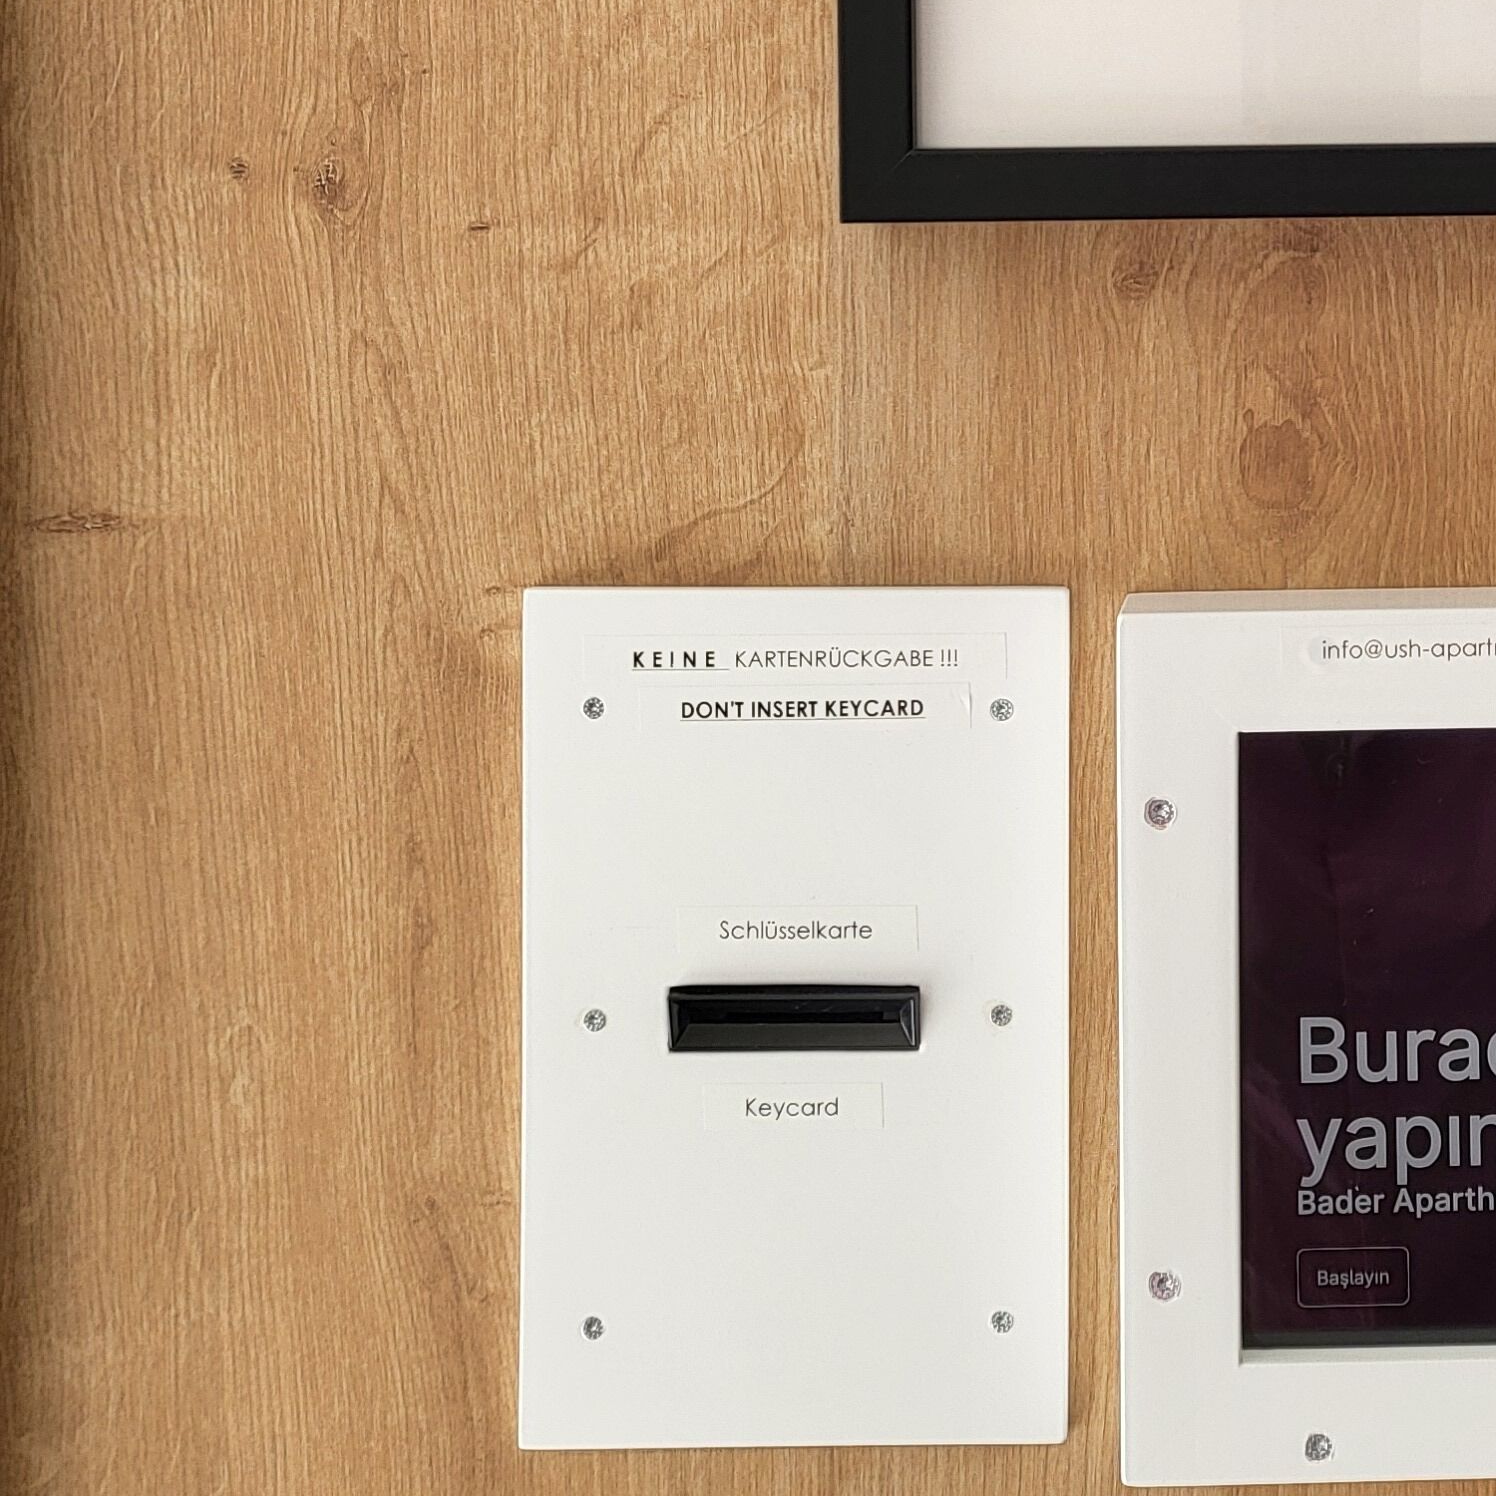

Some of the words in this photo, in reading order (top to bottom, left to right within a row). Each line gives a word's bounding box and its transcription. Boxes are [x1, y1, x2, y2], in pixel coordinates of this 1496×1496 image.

[633, 650, 715, 668] KEINE
[735, 646, 934, 668] KARTENRÜCKGABE
[940, 648, 958, 667] !!!
[681, 700, 745, 719] DON'T
[751, 700, 818, 719] INSERT
[825, 699, 924, 717] KEYCARD
[719, 919, 873, 940] Schlüsselkarte
[745, 1097, 839, 1121] Keycard
[1297, 1188, 1385, 1216] Bader
[1317, 1269, 1390, 1289] Başlayın
